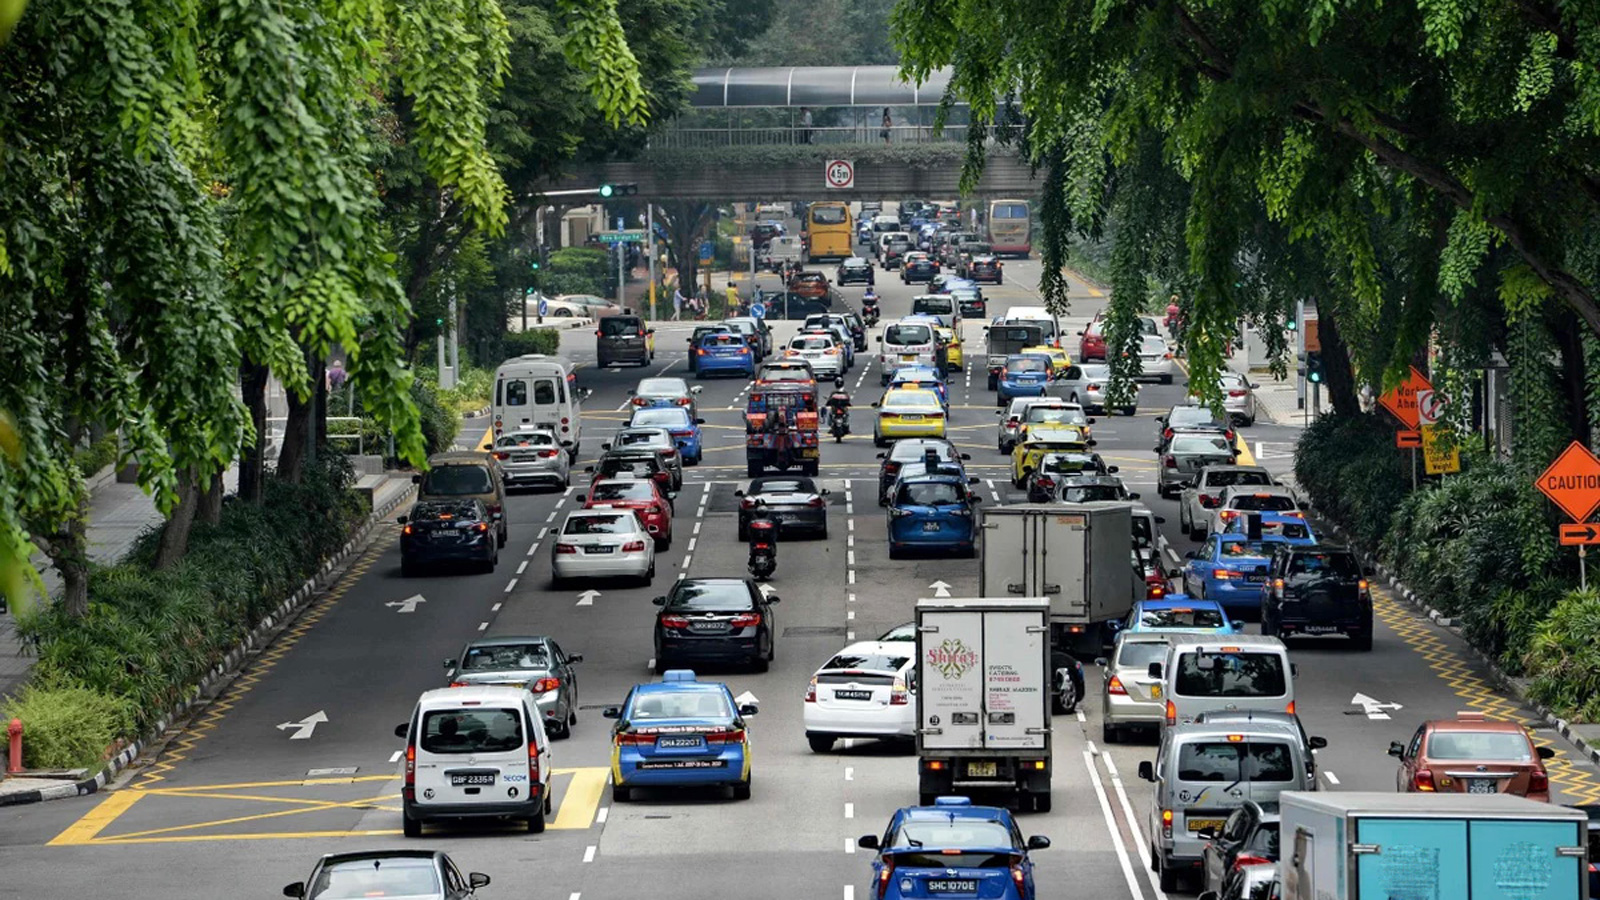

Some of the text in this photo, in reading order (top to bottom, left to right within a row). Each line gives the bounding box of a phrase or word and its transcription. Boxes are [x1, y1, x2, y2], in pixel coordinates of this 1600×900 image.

[1432, 462, 1453, 471] Weight
[1548, 474, 1600, 490] CAUTIO
[928, 649, 976, 668] Shiraz
[929, 881, 975, 890] SHC1070E
